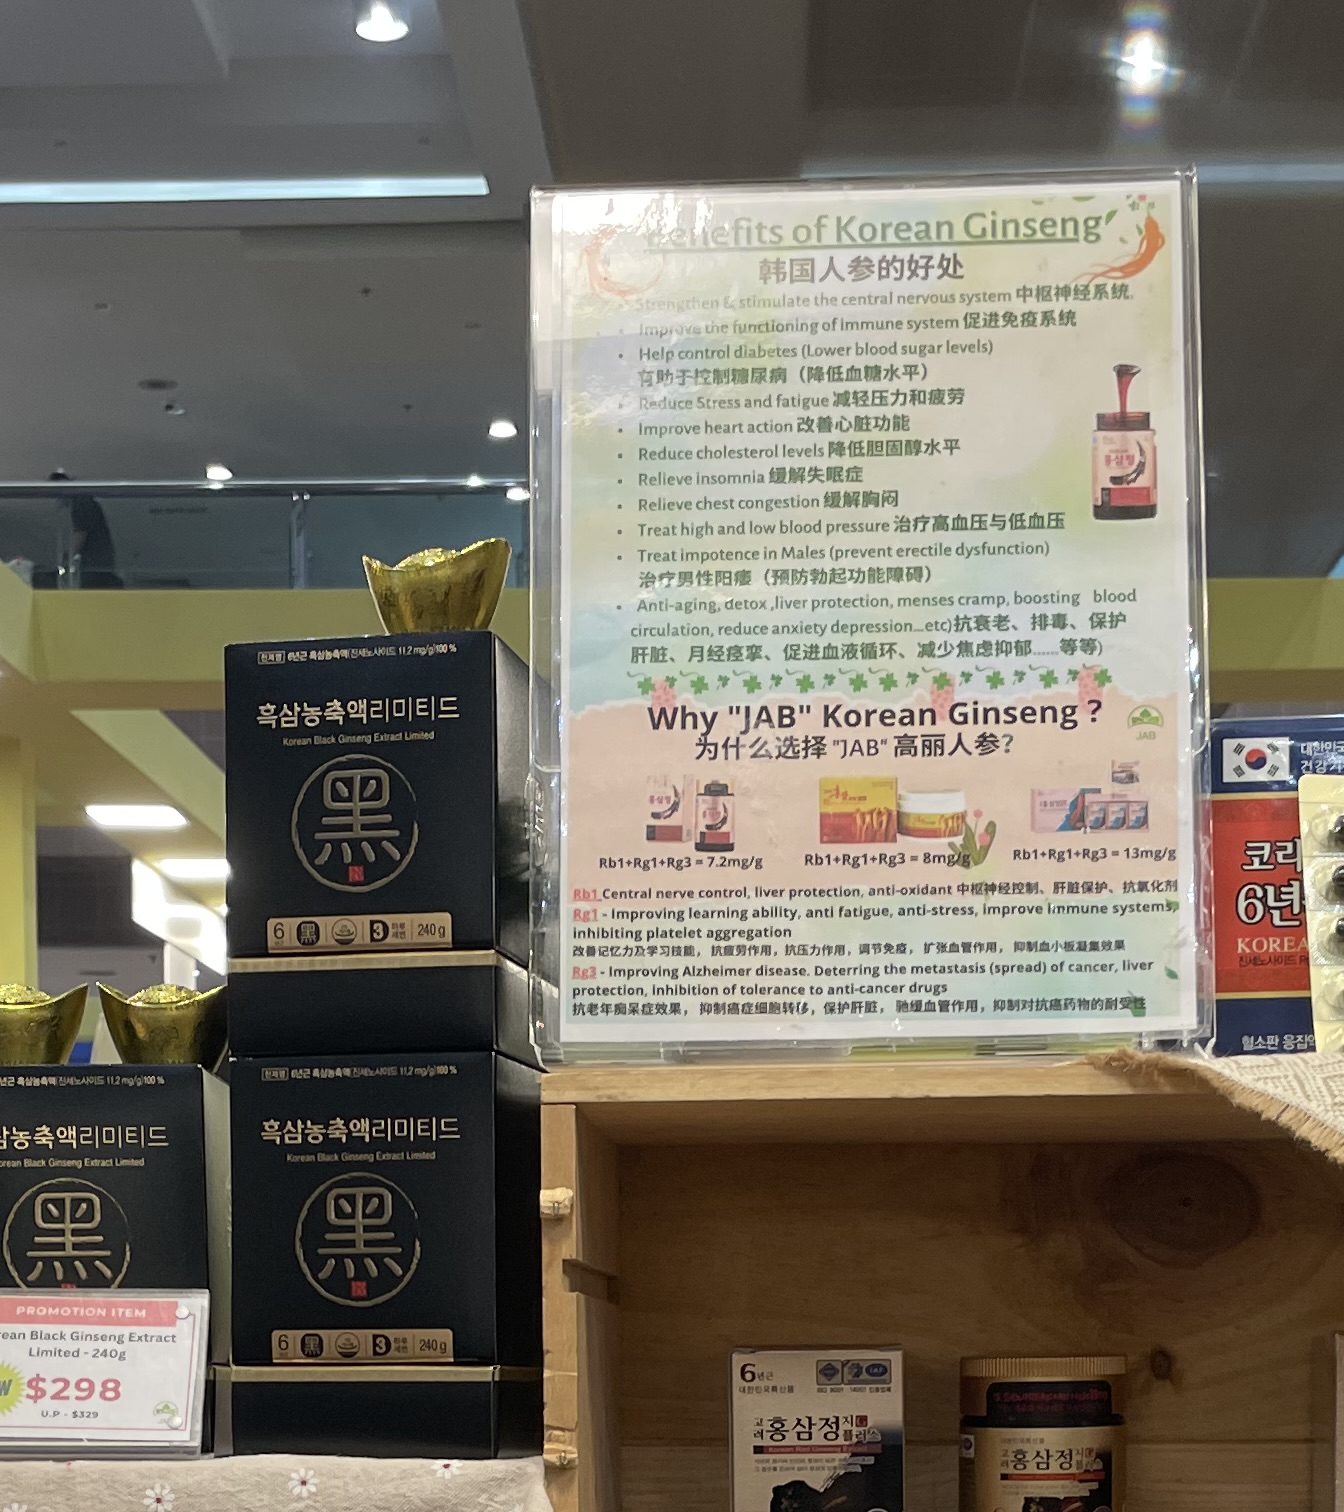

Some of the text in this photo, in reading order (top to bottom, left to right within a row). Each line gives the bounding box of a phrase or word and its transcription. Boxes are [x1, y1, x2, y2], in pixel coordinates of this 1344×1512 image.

[792, 212, 1103, 245] of Korean Ginseng
[758, 254, 965, 285] 韩国人参的好处
[639, 339, 994, 363] Help control diabetes (Lower blood sugar levels)
[638, 414, 910, 438] Improve heart action 改善心脏功能
[638, 467, 864, 487] Relieve insomnia 缓解失眠症
[256, 695, 460, 728] 흑삼농축액리미티드
[648, 699, 1103, 735] Why "JAB" Korean Ginseng ?
[695, 733, 1014, 761] 为什么选择 "JAB" 高丽人参?
[16, 1306, 146, 1318] PROMOTION ITEM
[30, 1330, 66, 1342] Black
[70, 1331, 125, 1344] Ginseng
[128, 1331, 177, 1343] Extract
[29, 1347, 127, 1361] Limited 240g
[25, 1373, 122, 1404] $298
